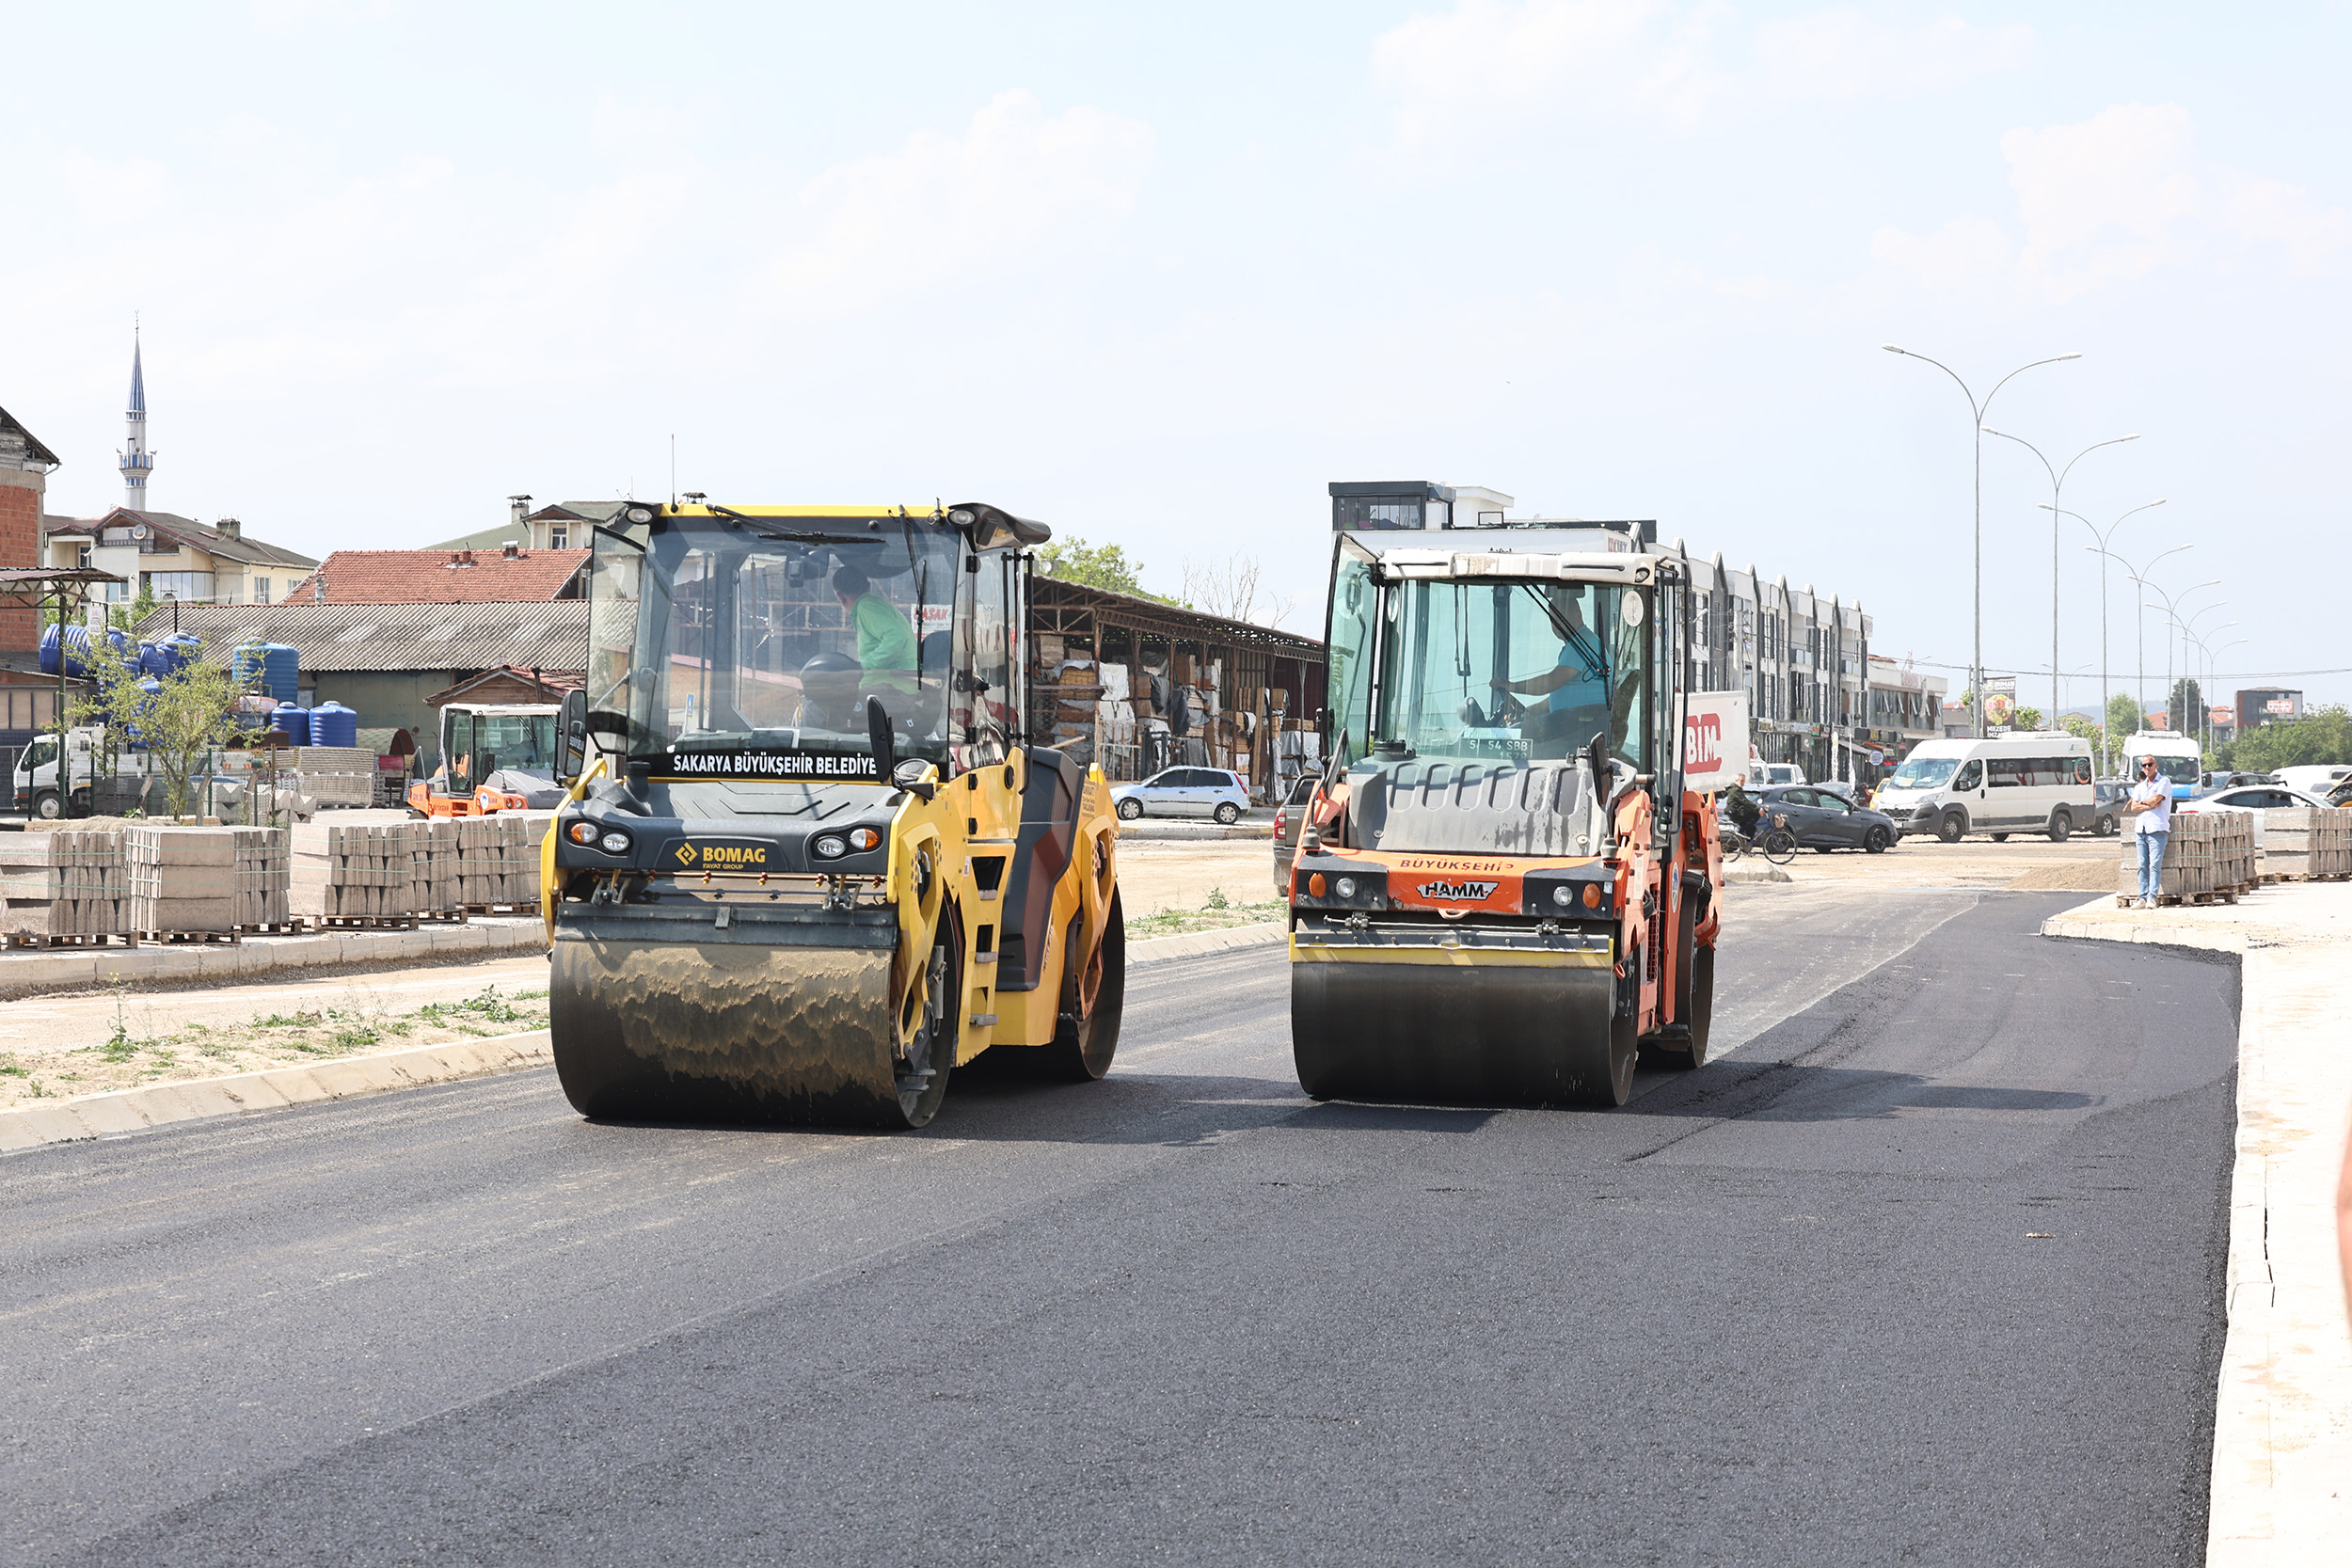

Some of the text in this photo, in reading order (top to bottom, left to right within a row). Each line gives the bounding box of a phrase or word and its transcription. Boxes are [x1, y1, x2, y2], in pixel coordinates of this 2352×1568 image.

[1488, 740, 1528, 752] 54 SBB
[674, 754, 729, 772] SAKARYA
[735, 751, 813, 775] BÜYÜKŞEHİR
[703, 847, 766, 863] BOMAG
[1425, 882, 1484, 897] HAMM
